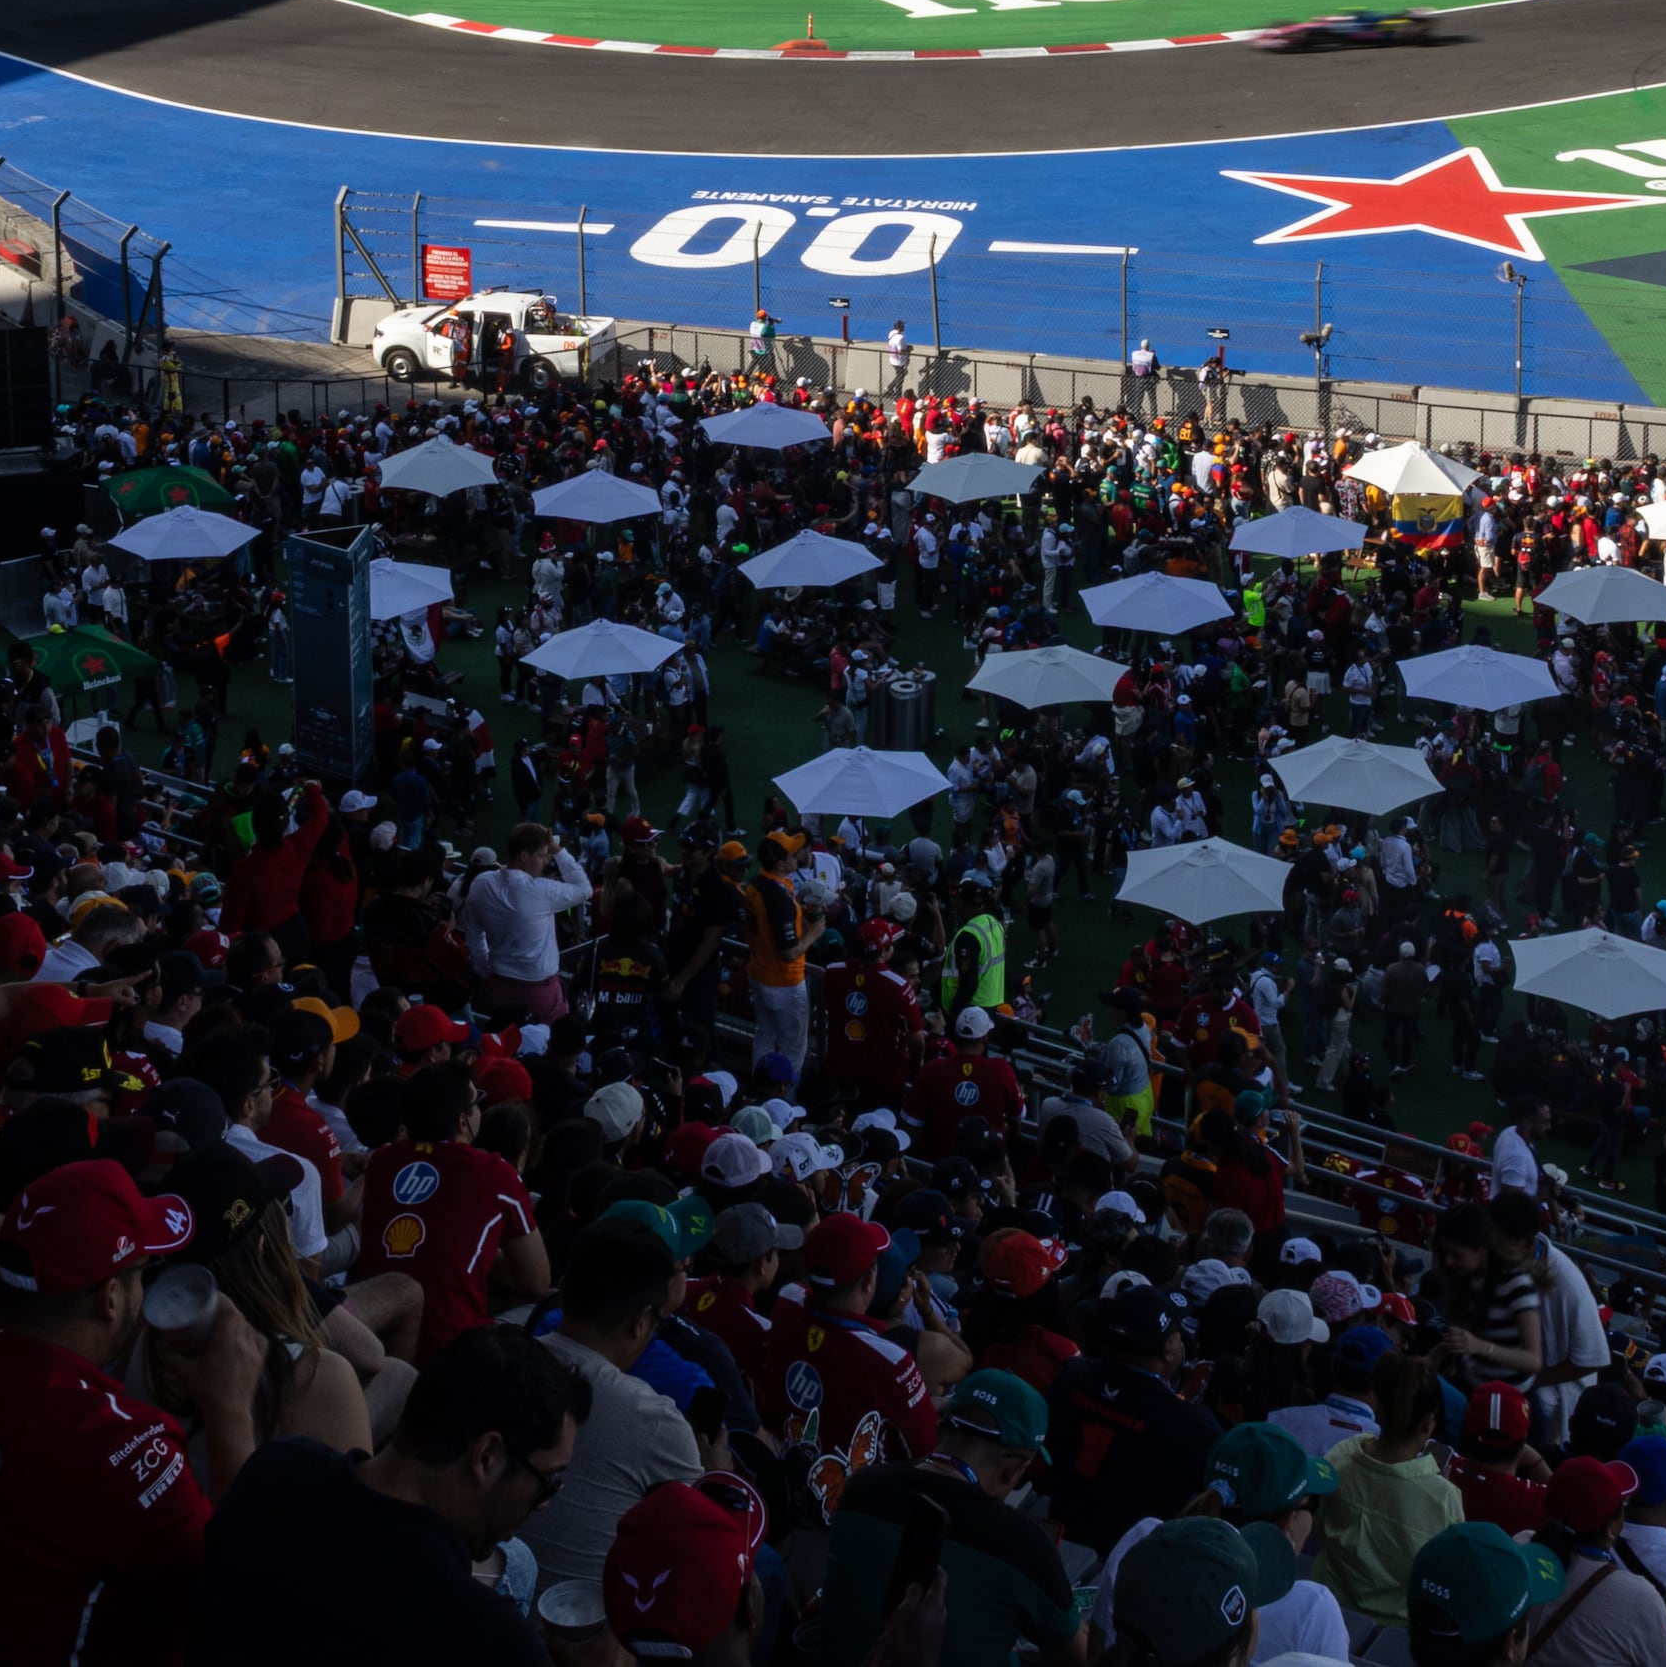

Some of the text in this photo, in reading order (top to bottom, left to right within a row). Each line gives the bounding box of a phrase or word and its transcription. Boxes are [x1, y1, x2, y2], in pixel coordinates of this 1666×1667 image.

[691, 189, 833, 206] SANAMENTE
[629, 203, 964, 277] 0.0
[563, 341, 576, 350] 09
[846, 991, 867, 1016] hp
[955, 1081, 978, 1106] hp
[396, 1161, 437, 1205] hp
[165, 1207, 187, 1236] 44
[690, 1214, 706, 1236] 14
[787, 1360, 821, 1410] hp
[973, 1389, 998, 1405] BOSS
[108, 1422, 166, 1467] Bitdefender
[131, 1437, 169, 1484] ZCG
[1214, 1461, 1239, 1478] BOSS
[1537, 1558, 1559, 1583] 14
[1421, 1578, 1451, 1600] BOSS
